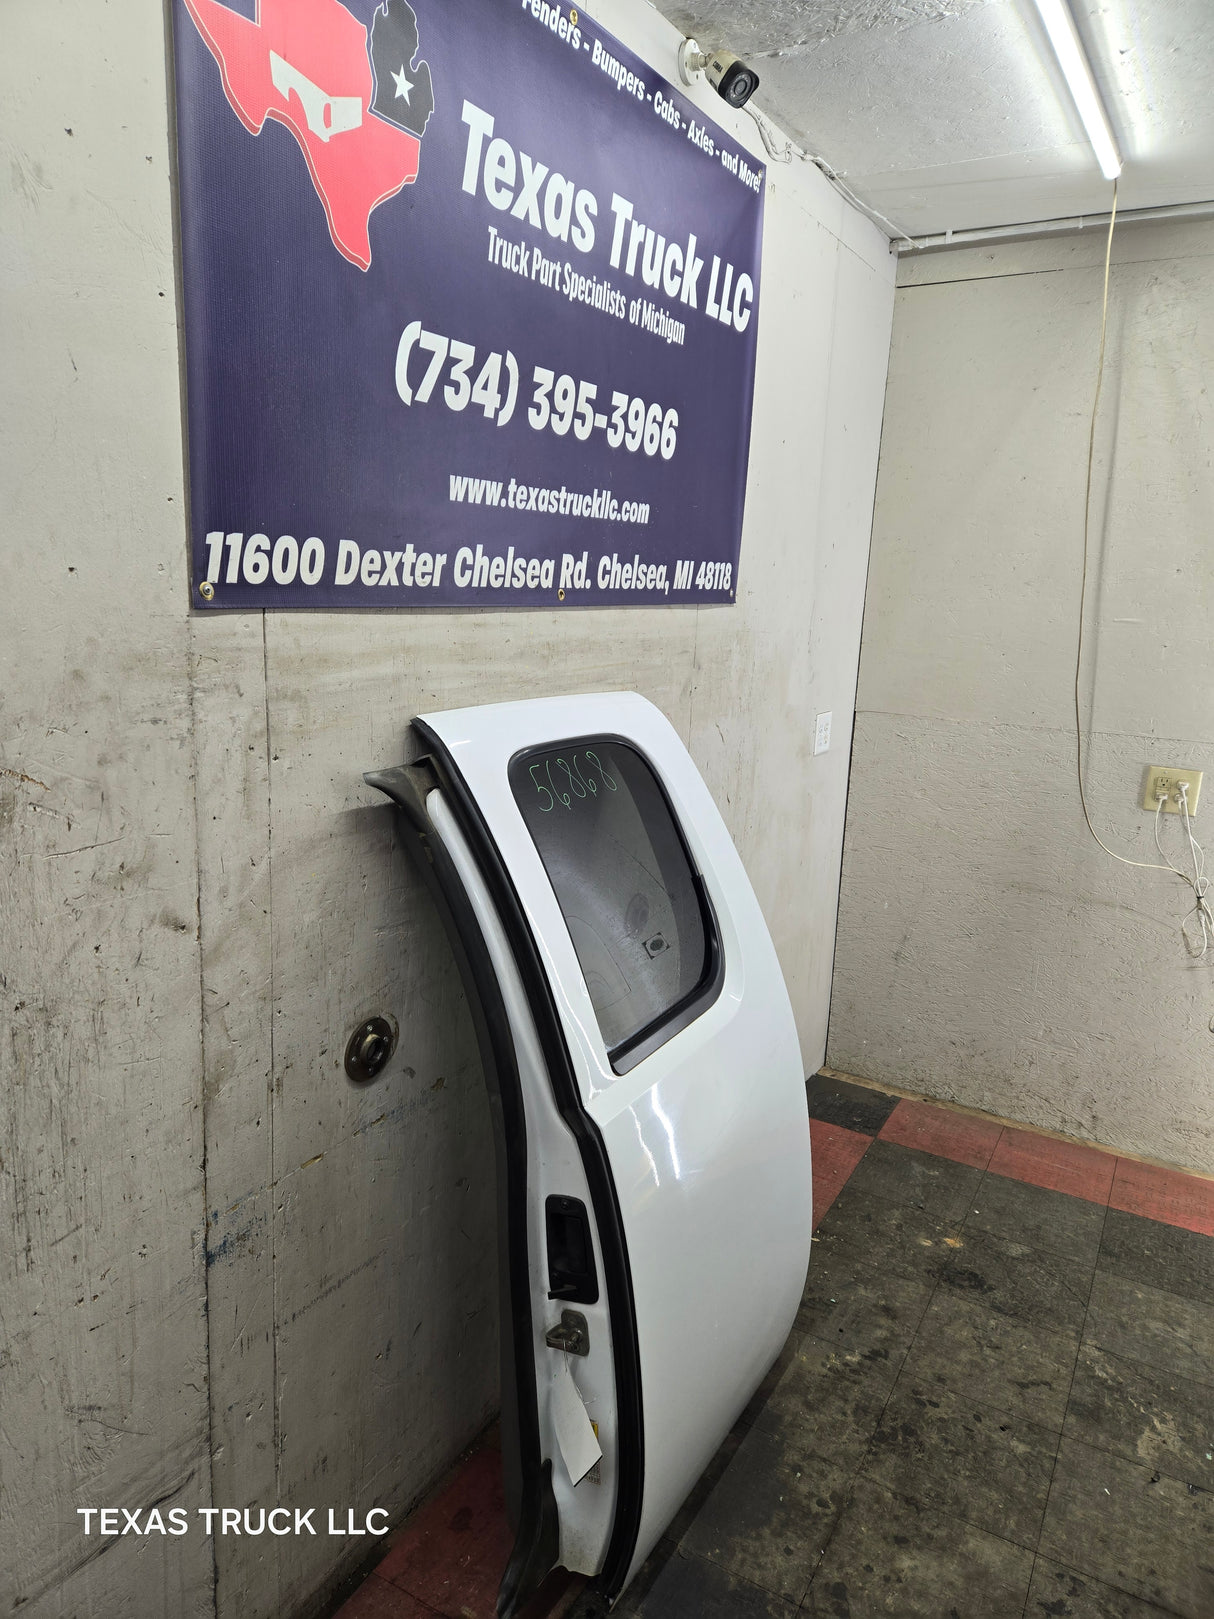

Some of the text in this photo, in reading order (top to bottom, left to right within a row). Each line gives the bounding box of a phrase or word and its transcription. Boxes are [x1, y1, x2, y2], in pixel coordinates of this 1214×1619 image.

[591, 39, 645, 101] Bumpers
[654, 91, 681, 129] Cabs
[687, 120, 714, 156] Axles
[721, 150, 739, 175] and
[739, 160, 762, 193] More!
[461, 99, 754, 332] Texas Truck LLC
[488, 225, 686, 345] Truck Part Specialists of Michigan
[395, 320, 679, 460] (734) 395-3966
[449, 474, 650, 524] www.texastruckllc.com
[205, 531, 732, 595] 11600 Dexter Chelsea Rd. Chelsea, MI 48118
[529, 751, 617, 812] 56868
